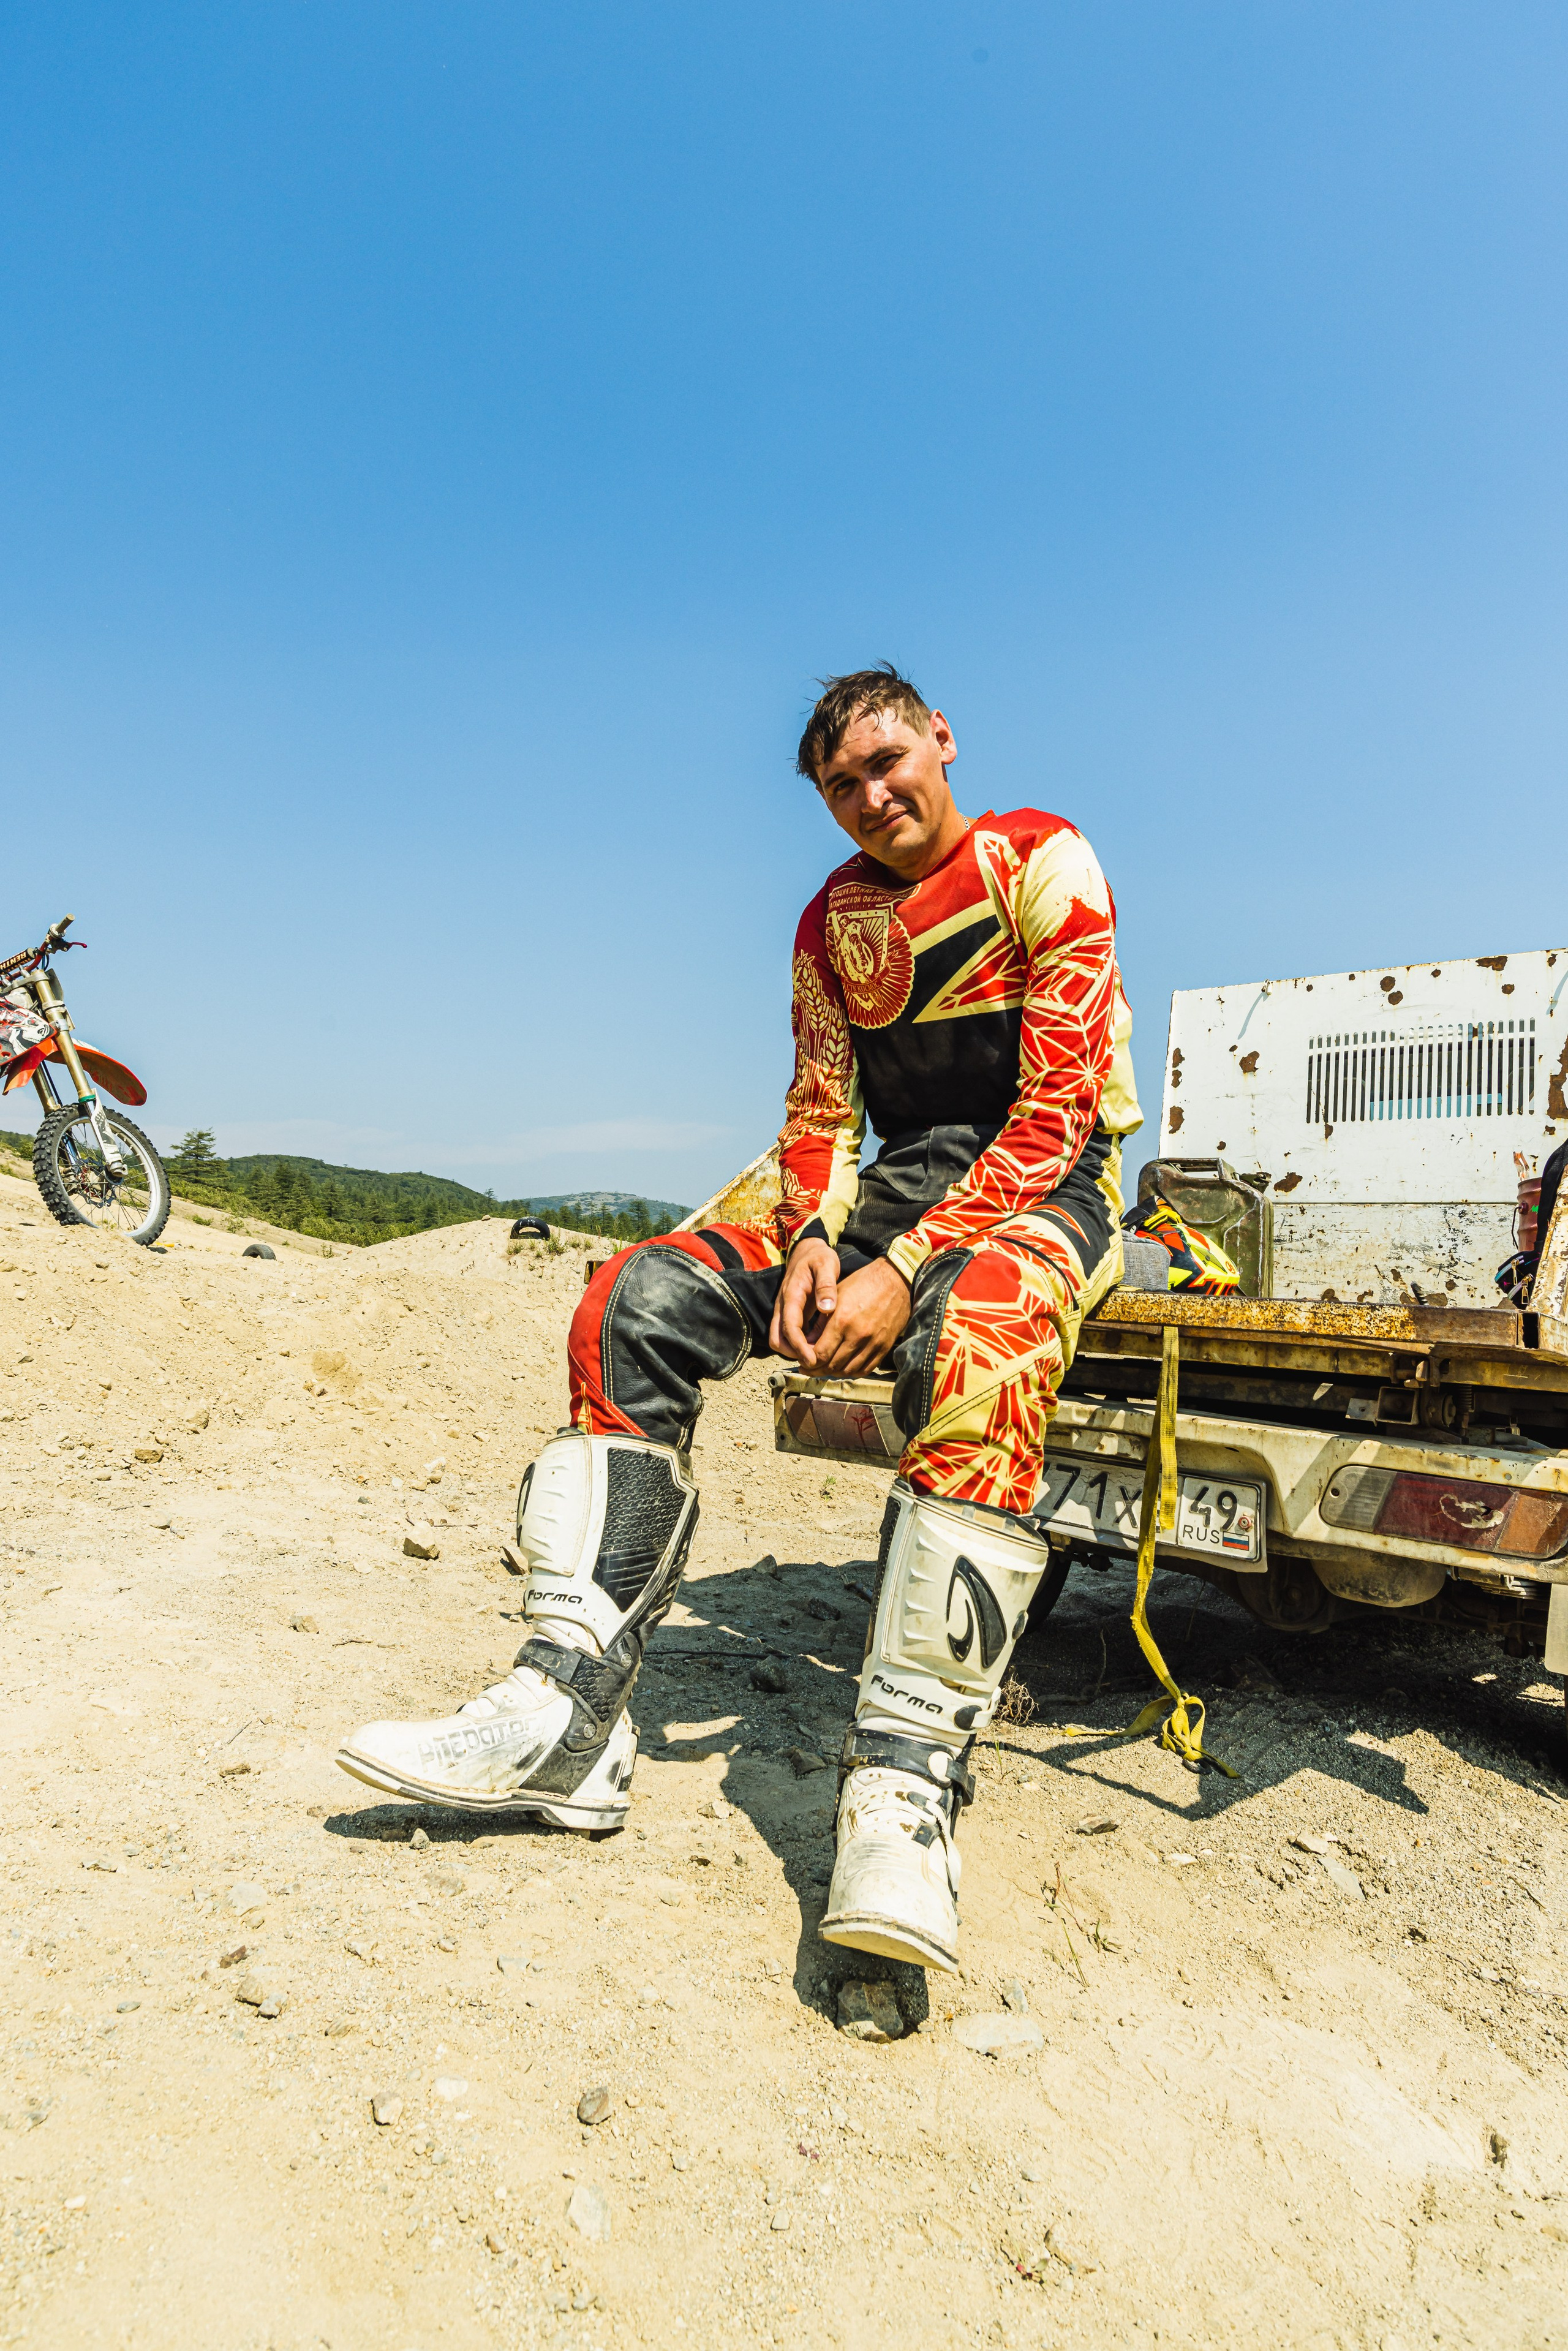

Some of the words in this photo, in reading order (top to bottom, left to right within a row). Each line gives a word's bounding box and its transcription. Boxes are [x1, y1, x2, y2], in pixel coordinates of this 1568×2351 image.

[846, 983, 857, 992] СТК
[858, 980, 880, 992] КОСМОС
[1190, 1486, 1238, 1531] 49
[1182, 1524, 1220, 1544] RUS
